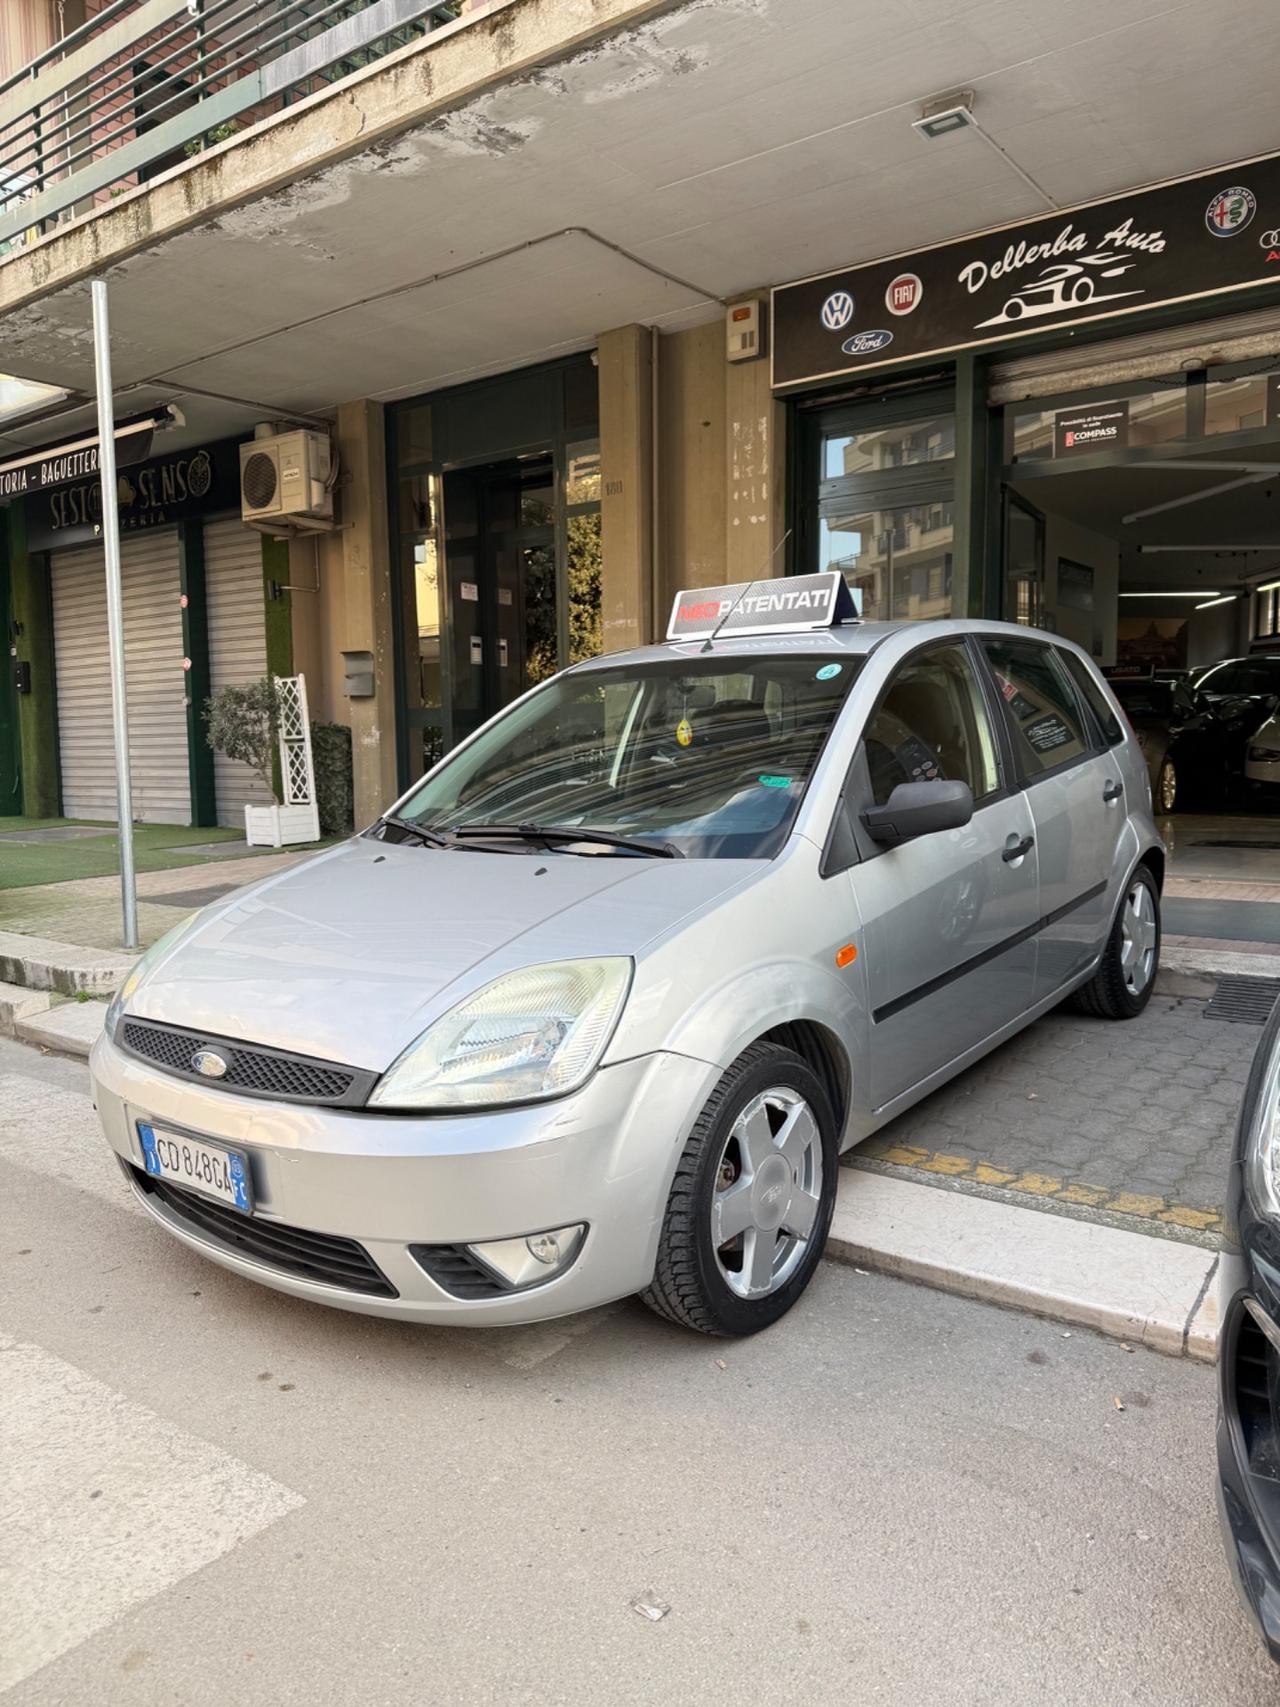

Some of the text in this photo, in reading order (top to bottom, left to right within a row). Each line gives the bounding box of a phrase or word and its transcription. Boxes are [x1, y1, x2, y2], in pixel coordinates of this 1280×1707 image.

[1228, 189, 1254, 208] ROMEO
[957, 217, 1166, 294] Dellerba Auto
[1264, 251, 1280, 262] A
[894, 284, 914, 305] FIAT
[851, 333, 883, 352] Ford
[1074, 426, 1117, 440] COMPASS
[679, 589, 830, 620] NEOPATENTATI
